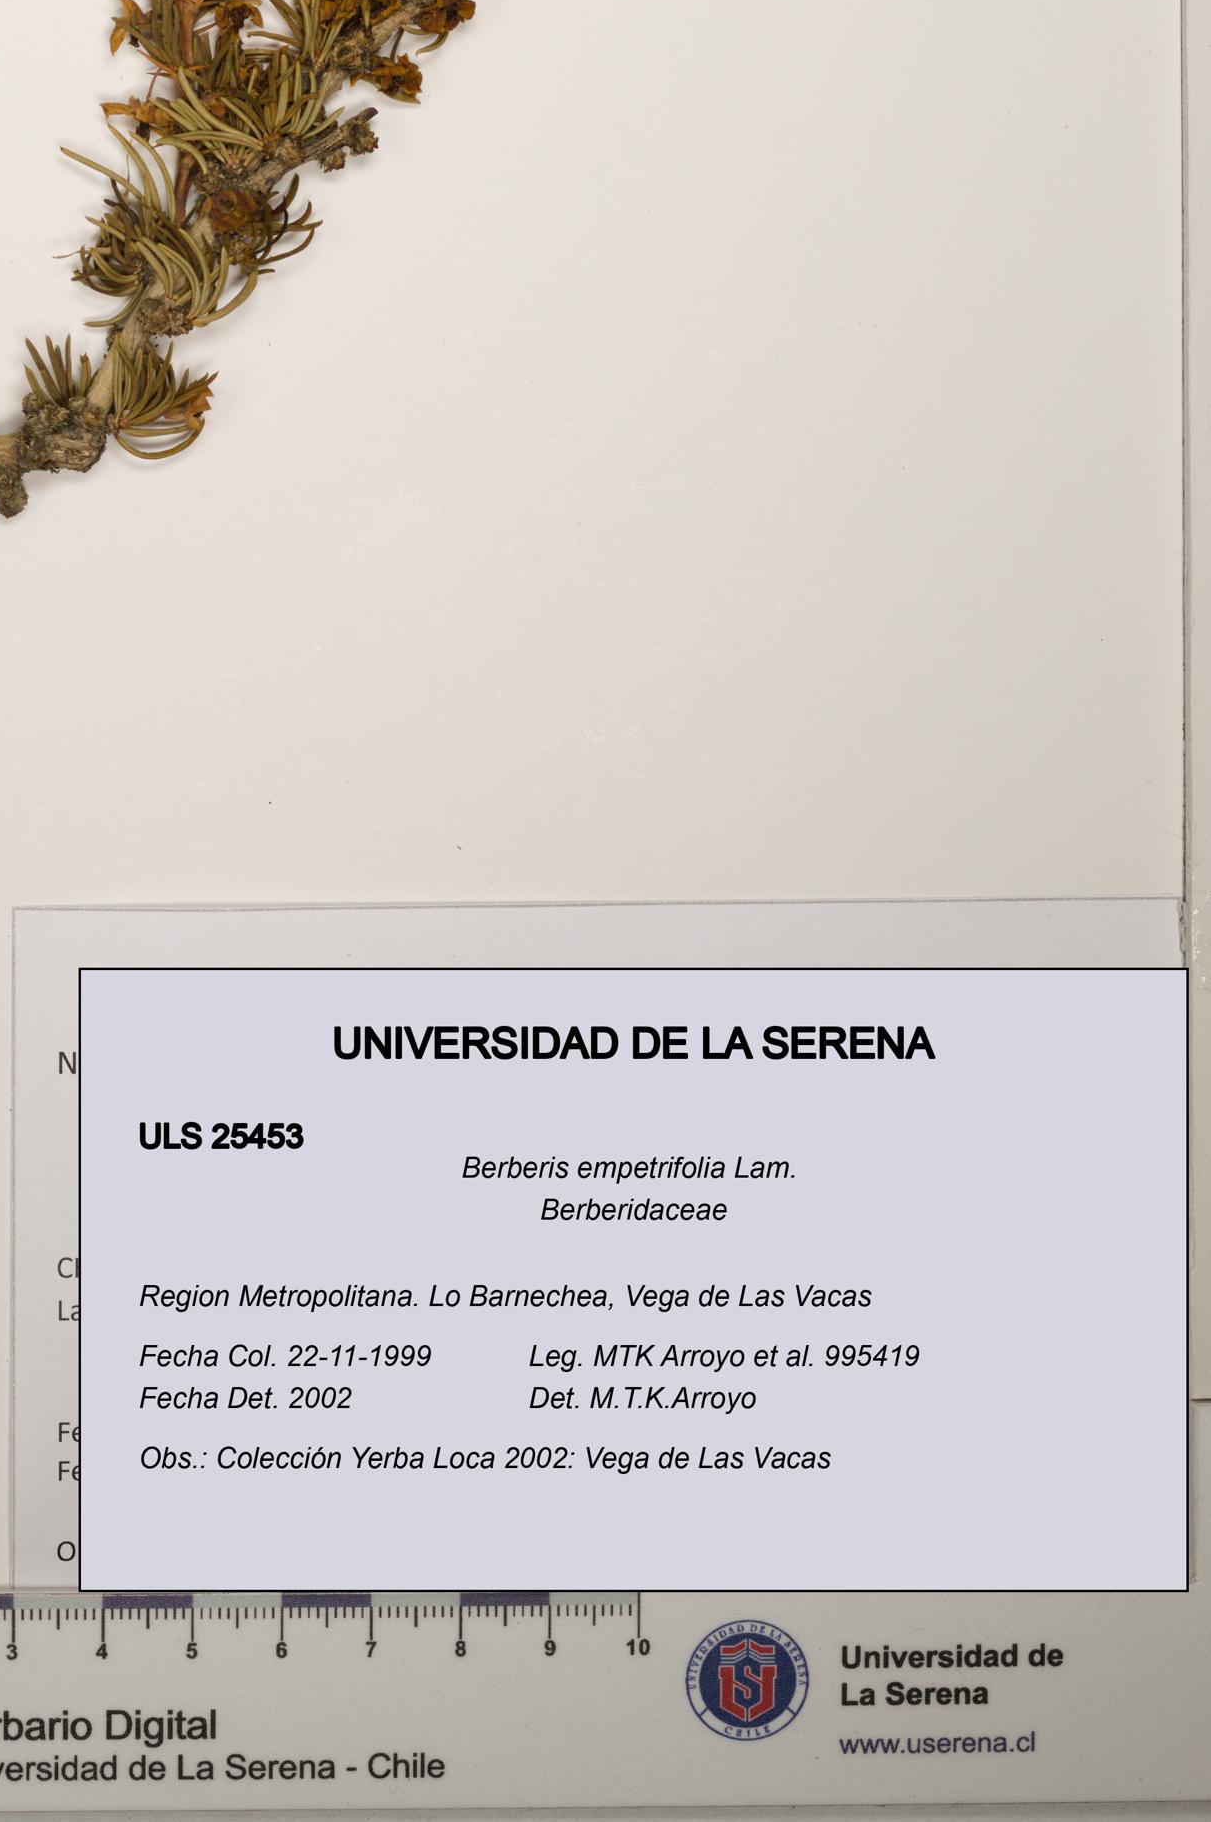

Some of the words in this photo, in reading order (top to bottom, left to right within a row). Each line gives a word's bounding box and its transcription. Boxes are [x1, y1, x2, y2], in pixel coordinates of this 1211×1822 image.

[6, 1643, 18, 1660] 3
[96, 1642, 108, 1660] 4
[186, 1641, 198, 1659] 5
[276, 1641, 288, 1658] 6
[366, 1640, 377, 1658] 7
[455, 1640, 467, 1657] 8
[544, 1639, 556, 1656] 9
[627, 1639, 650, 1656] 10
[842, 1643, 1018, 1669] Universidad
[1028, 1643, 1063, 1667] de
[842, 1683, 875, 1706] La
[885, 1682, 988, 1706] Serena
[106, 1709, 216, 1748] Digital
[724, 1726, 771, 1738] CHILE
[839, 1731, 1035, 1755] www.userena.cl
[129, 1755, 166, 1781] de
[178, 1754, 213, 1780] La
[225, 1754, 335, 1780] Serena
[368, 1752, 445, 1779] Chile
